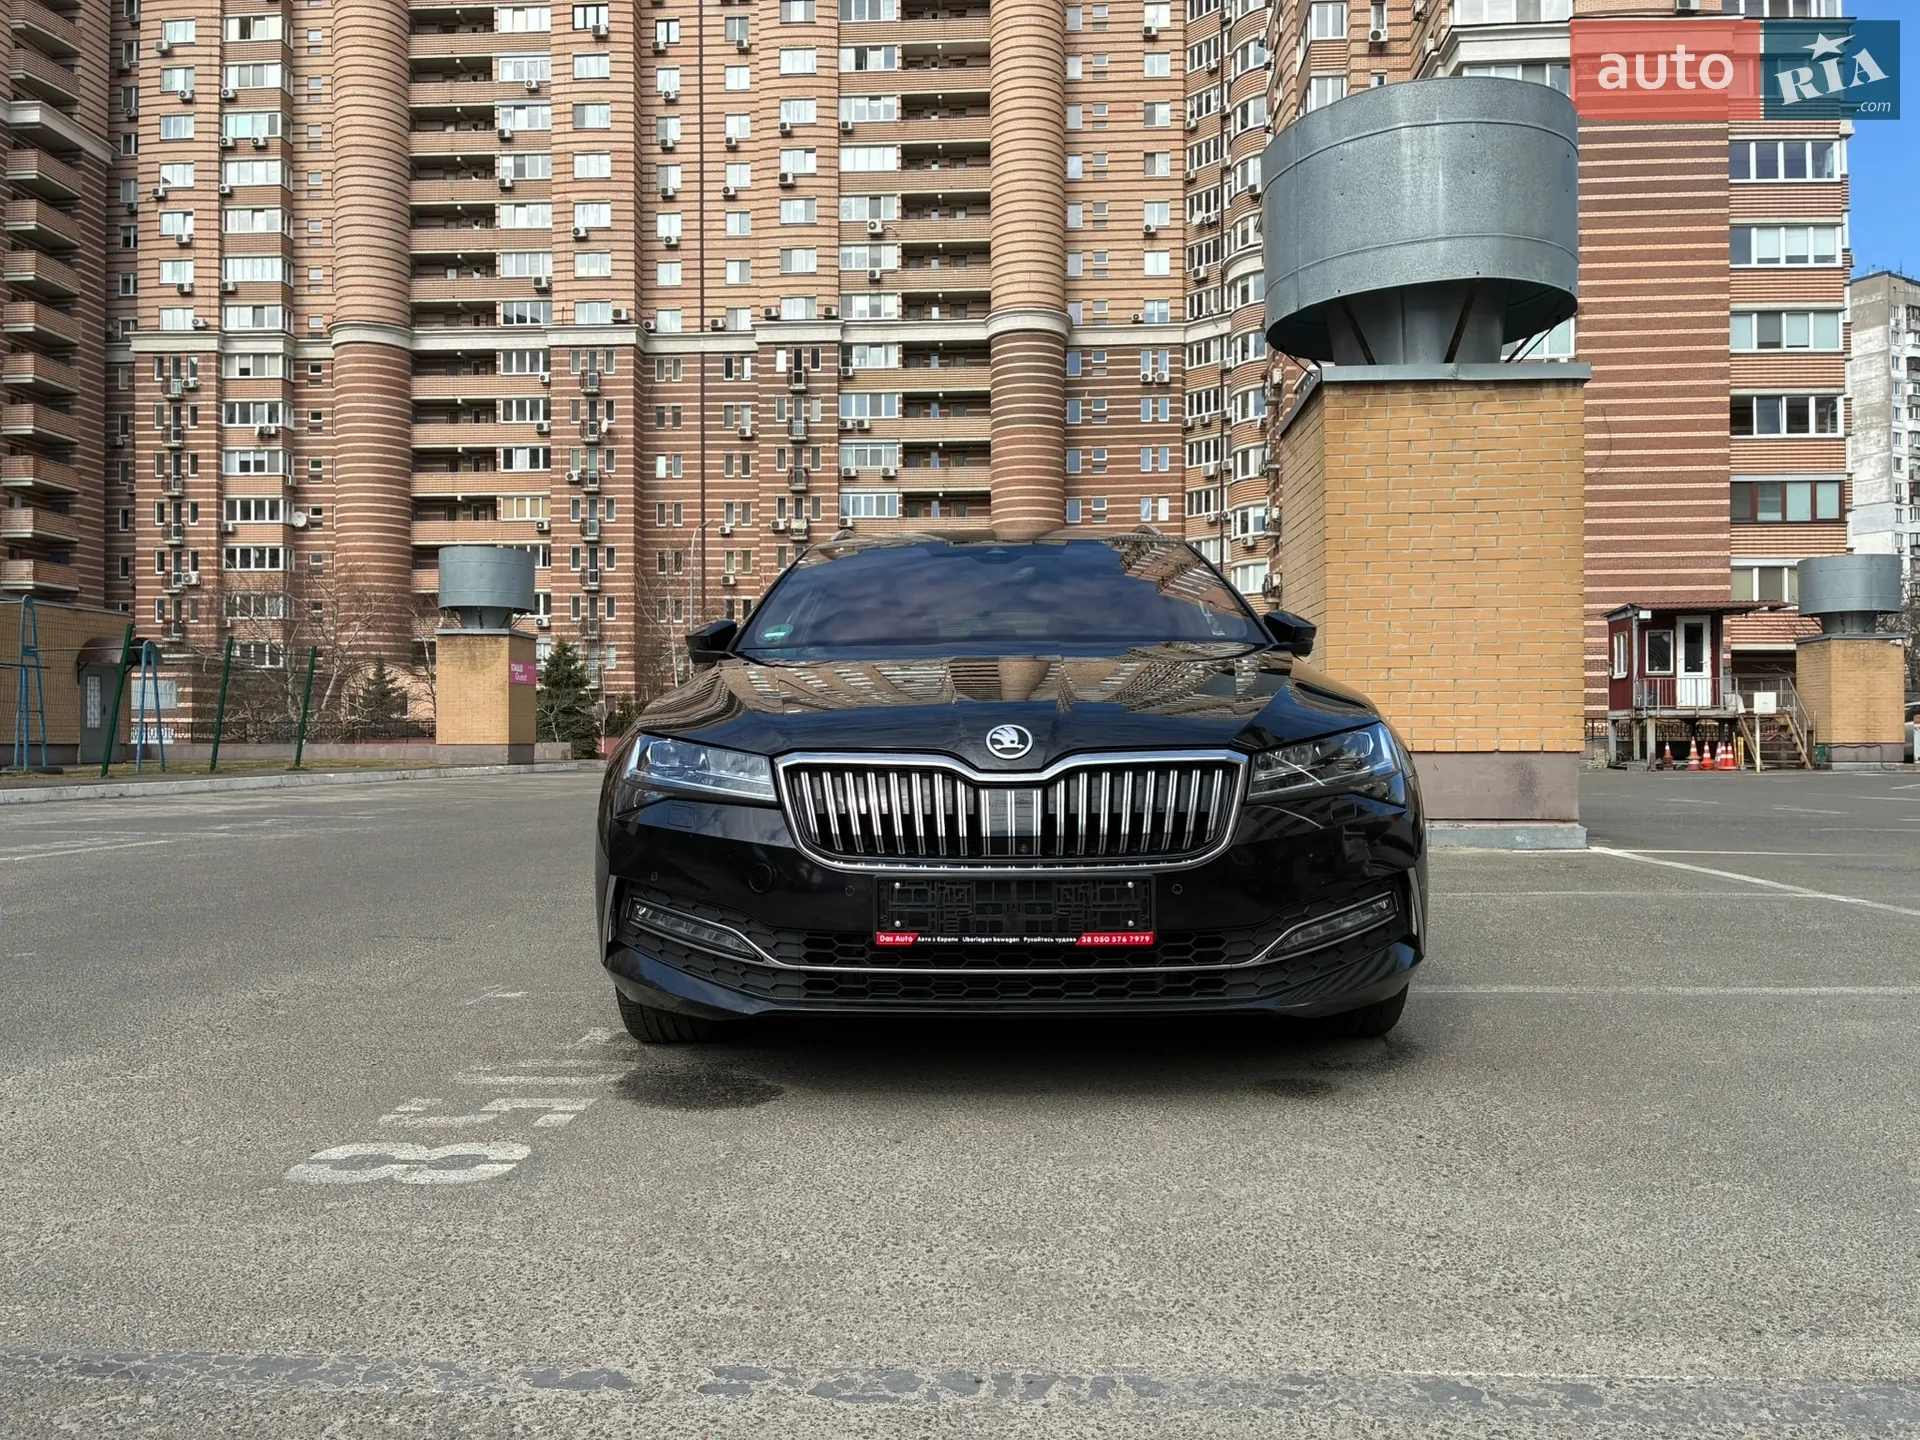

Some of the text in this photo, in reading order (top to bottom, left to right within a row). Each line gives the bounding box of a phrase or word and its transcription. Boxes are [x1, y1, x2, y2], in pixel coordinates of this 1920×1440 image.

[879, 934, 913, 943] Das Auto
[1081, 935, 1150, 943] 38 050 576 7979
